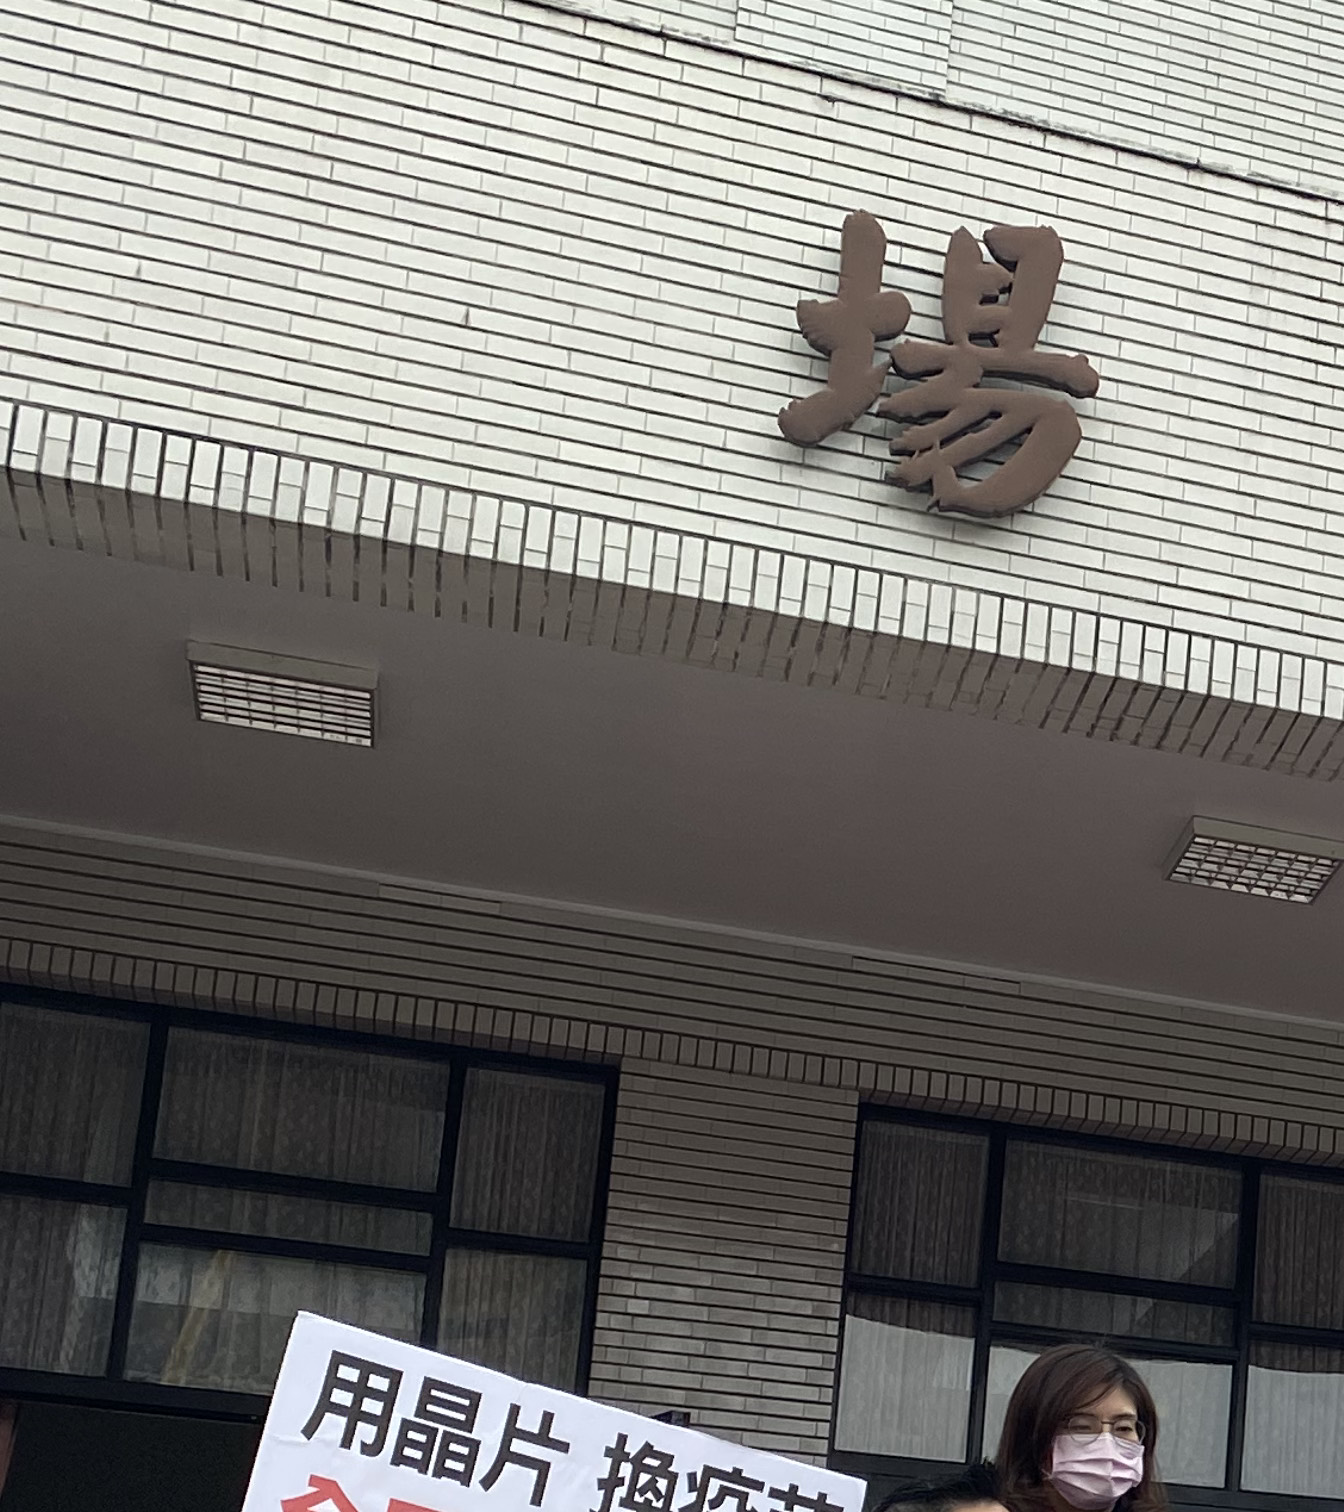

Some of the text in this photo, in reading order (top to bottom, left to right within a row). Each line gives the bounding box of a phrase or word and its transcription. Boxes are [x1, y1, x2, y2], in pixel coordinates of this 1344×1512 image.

[778, 210, 1101, 519] 場
[302, 1351, 569, 1506] 用晶片
